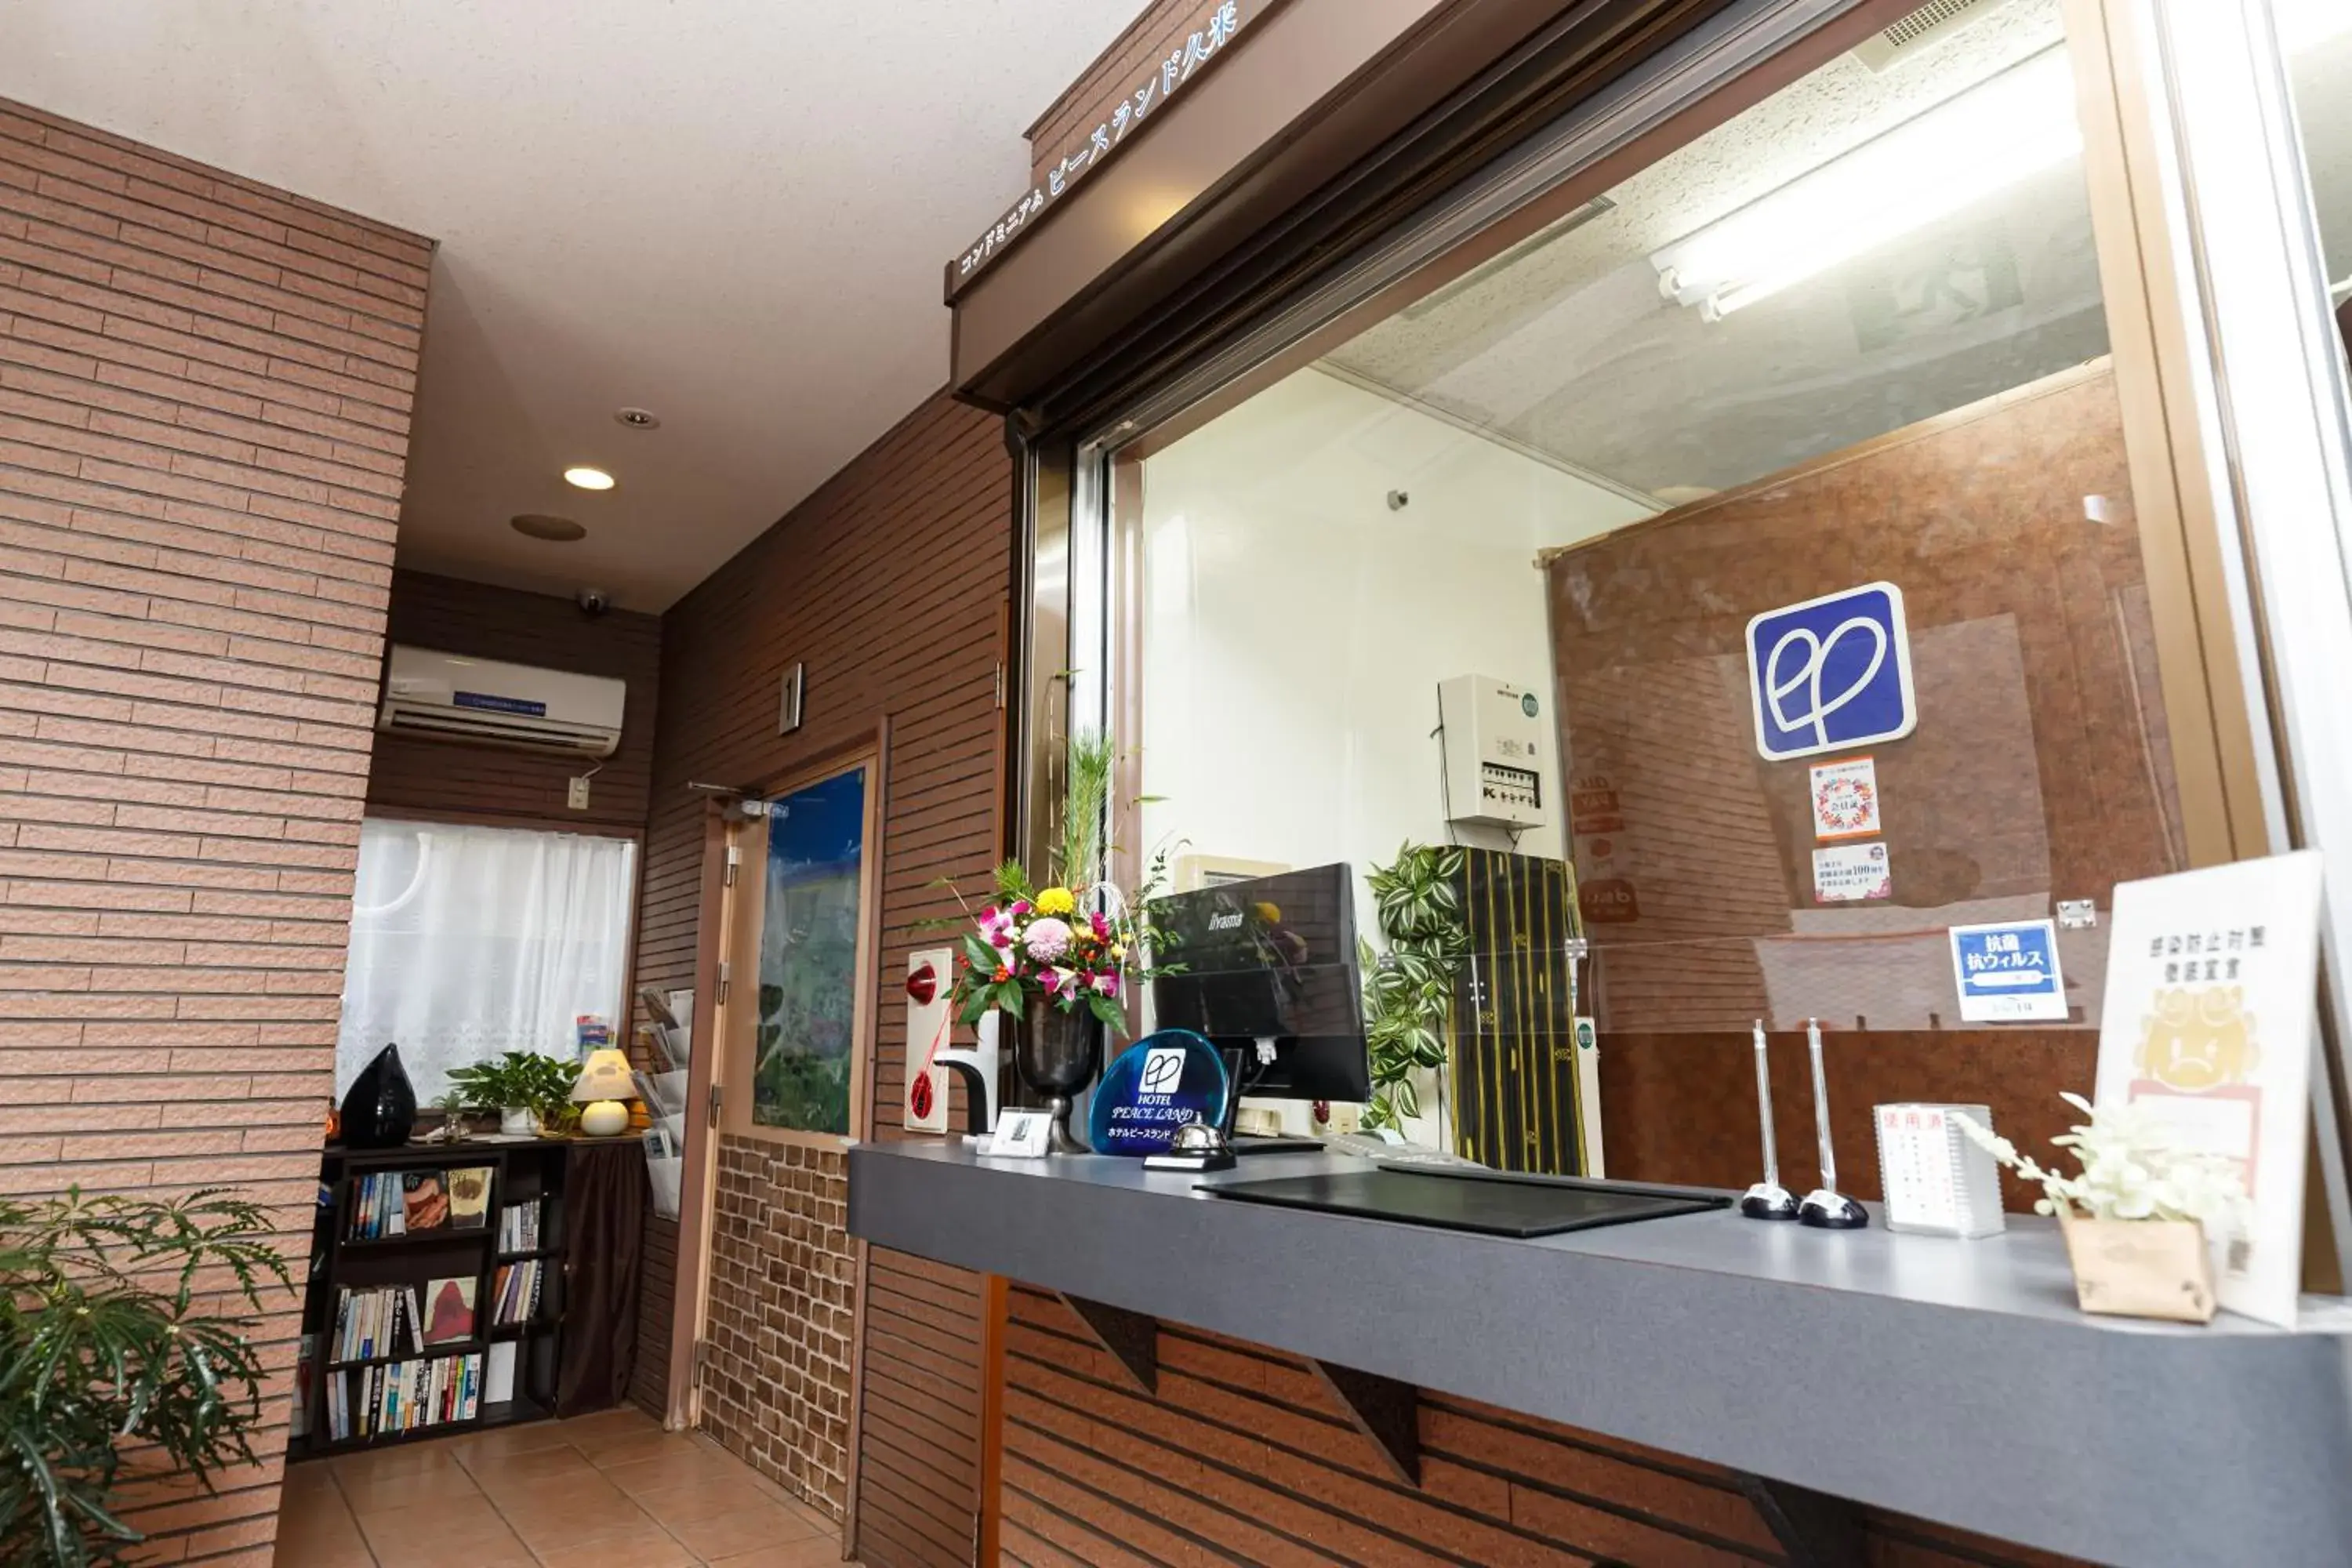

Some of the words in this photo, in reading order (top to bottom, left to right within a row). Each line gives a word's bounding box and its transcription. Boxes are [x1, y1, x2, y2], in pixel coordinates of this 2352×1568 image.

[960, 189, 1044, 274] コンドミニアム
[1208, 913, 1243, 931] iiyama
[1985, 933, 2020, 953] 抗菌
[1966, 950, 2045, 971] 抗ウィルス
[1138, 1094, 1172, 1106] HOTEL
[1112, 1107, 1153, 1120] PEACE
[1155, 1107, 1194, 1123] LAND
